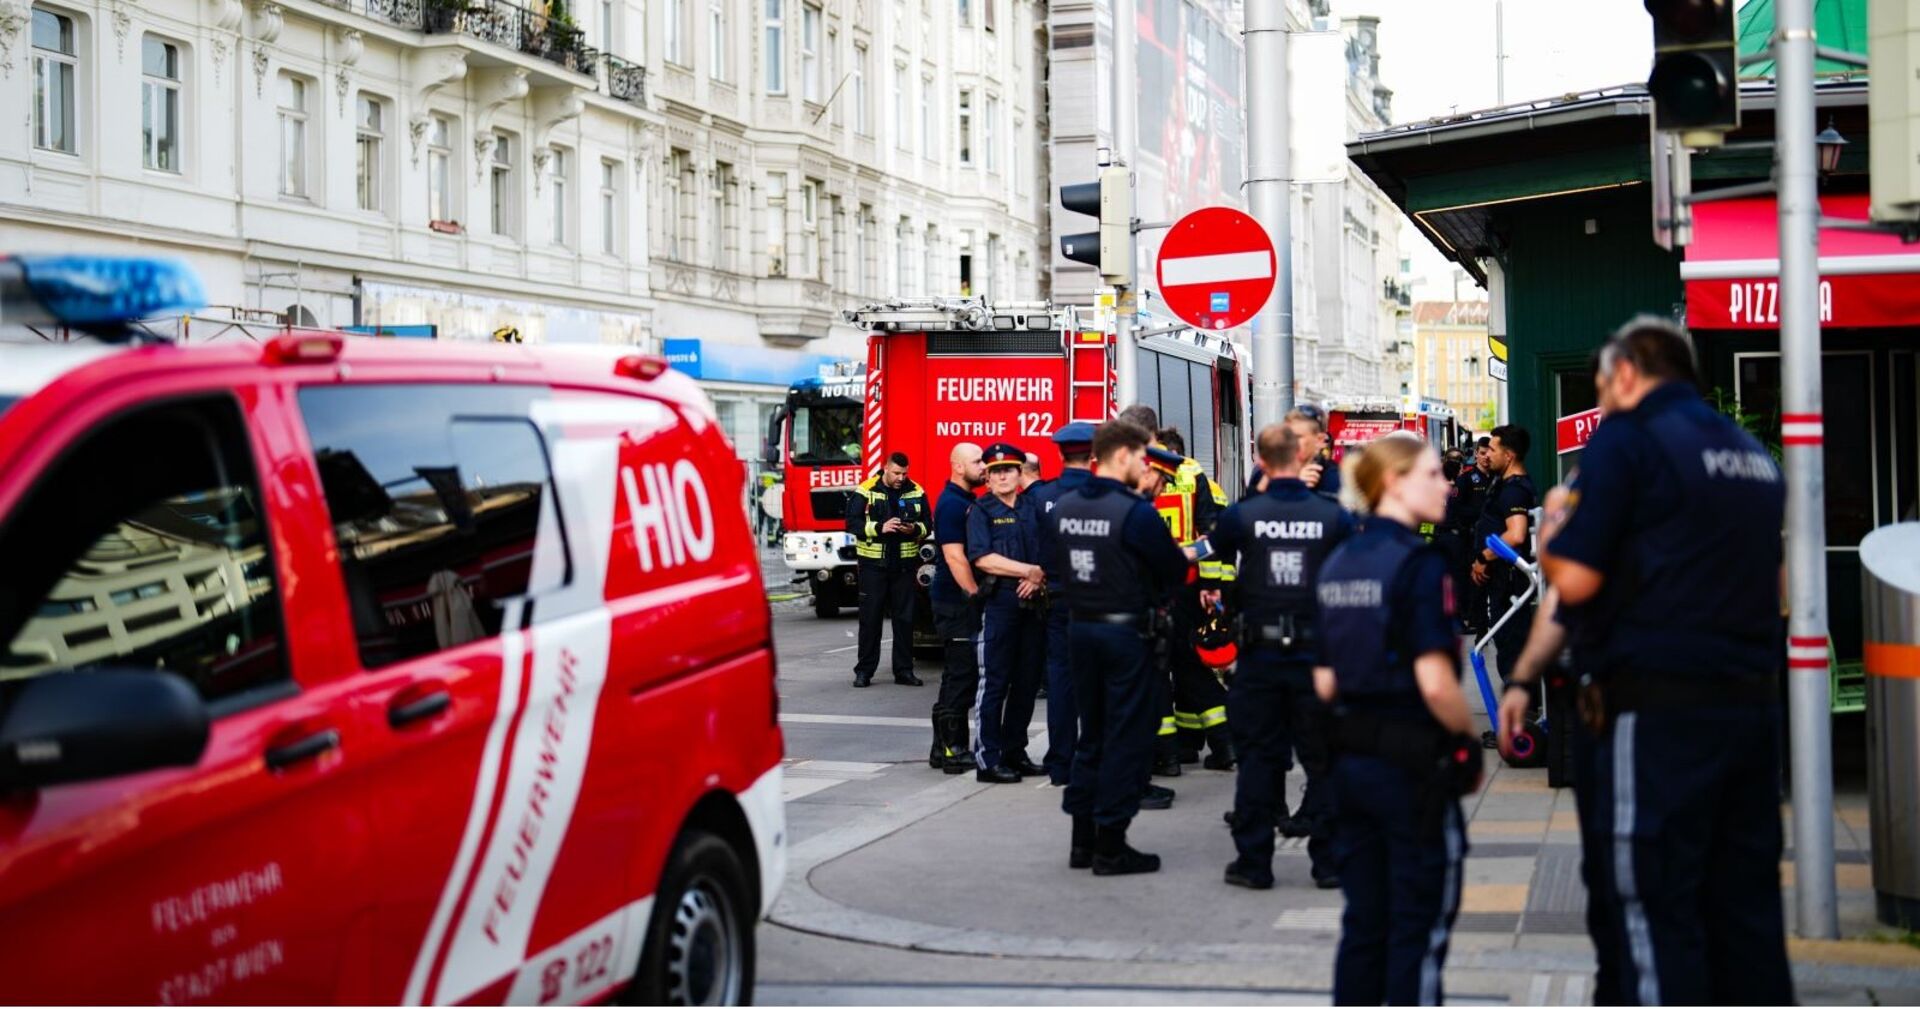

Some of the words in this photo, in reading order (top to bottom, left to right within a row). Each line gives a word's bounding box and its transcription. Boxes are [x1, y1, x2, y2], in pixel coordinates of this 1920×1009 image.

[1729, 281, 1832, 323] PIZZA
[937, 378, 1053, 401] FEUERWEHR
[936, 422, 1006, 436] NOTRUF
[1017, 412, 1053, 437] 122
[1059, 518, 1111, 537] POLIZEI
[1254, 520, 1324, 539] POLIZEI
[1069, 549, 1095, 571] BE
[1269, 551, 1303, 573] BE
[483, 647, 580, 946] FEUERWEHR
[152, 862, 282, 932] FEUERWEHR
[574, 933, 614, 989] 122
